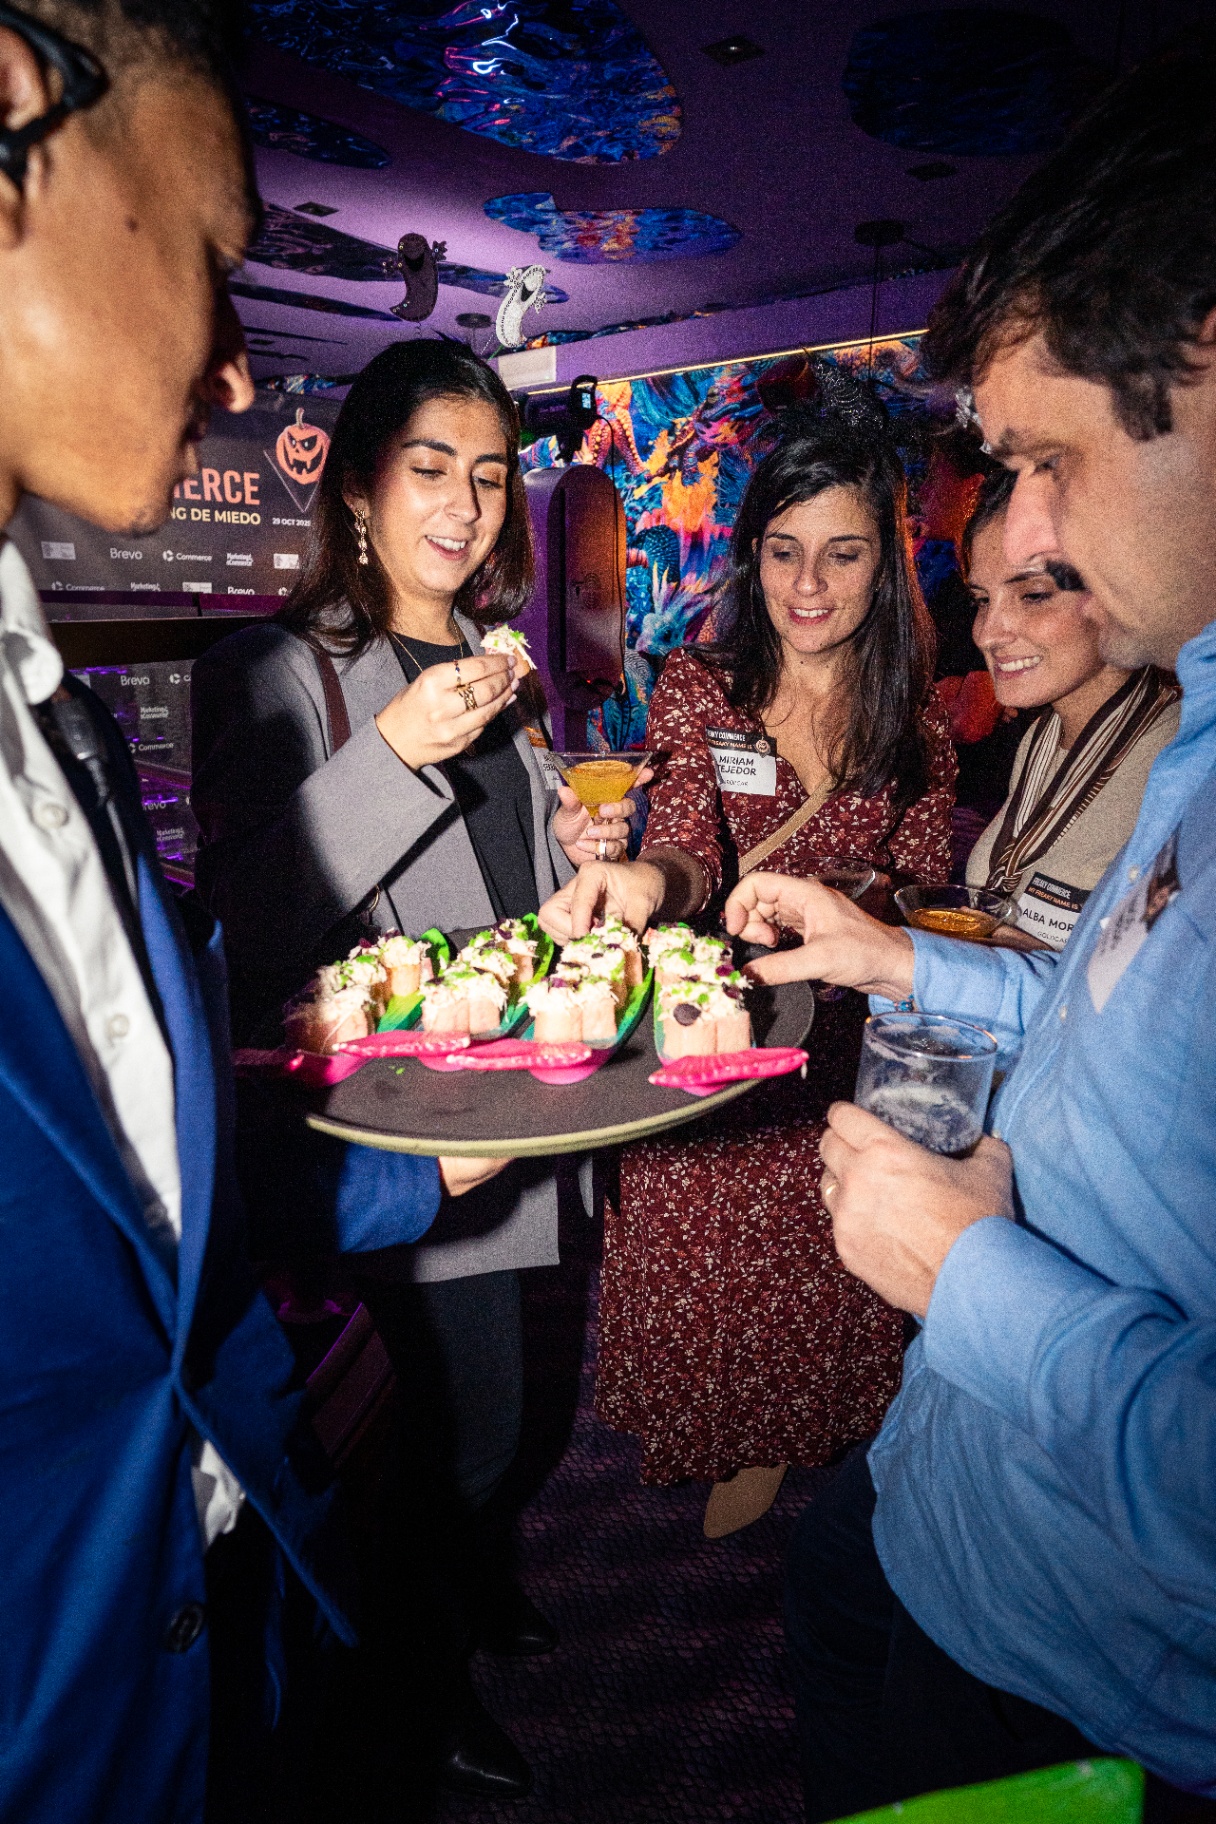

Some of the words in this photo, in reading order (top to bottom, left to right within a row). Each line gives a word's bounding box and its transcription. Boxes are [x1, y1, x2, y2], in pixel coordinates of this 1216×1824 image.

[191, 508, 211, 522] DE
[214, 510, 261, 525] MIEDO
[281, 518, 295, 526] OCT
[109, 547, 143, 560] Brevo
[176, 552, 213, 562] Commerce
[227, 586, 255, 595] Brevo
[120, 675, 150, 686] Brevo
[719, 755, 754, 767] MIRIAM
[1034, 889, 1054, 901] FREAKY
[1053, 897, 1071, 909] NAME
[1022, 908, 1045, 925] ALBA
